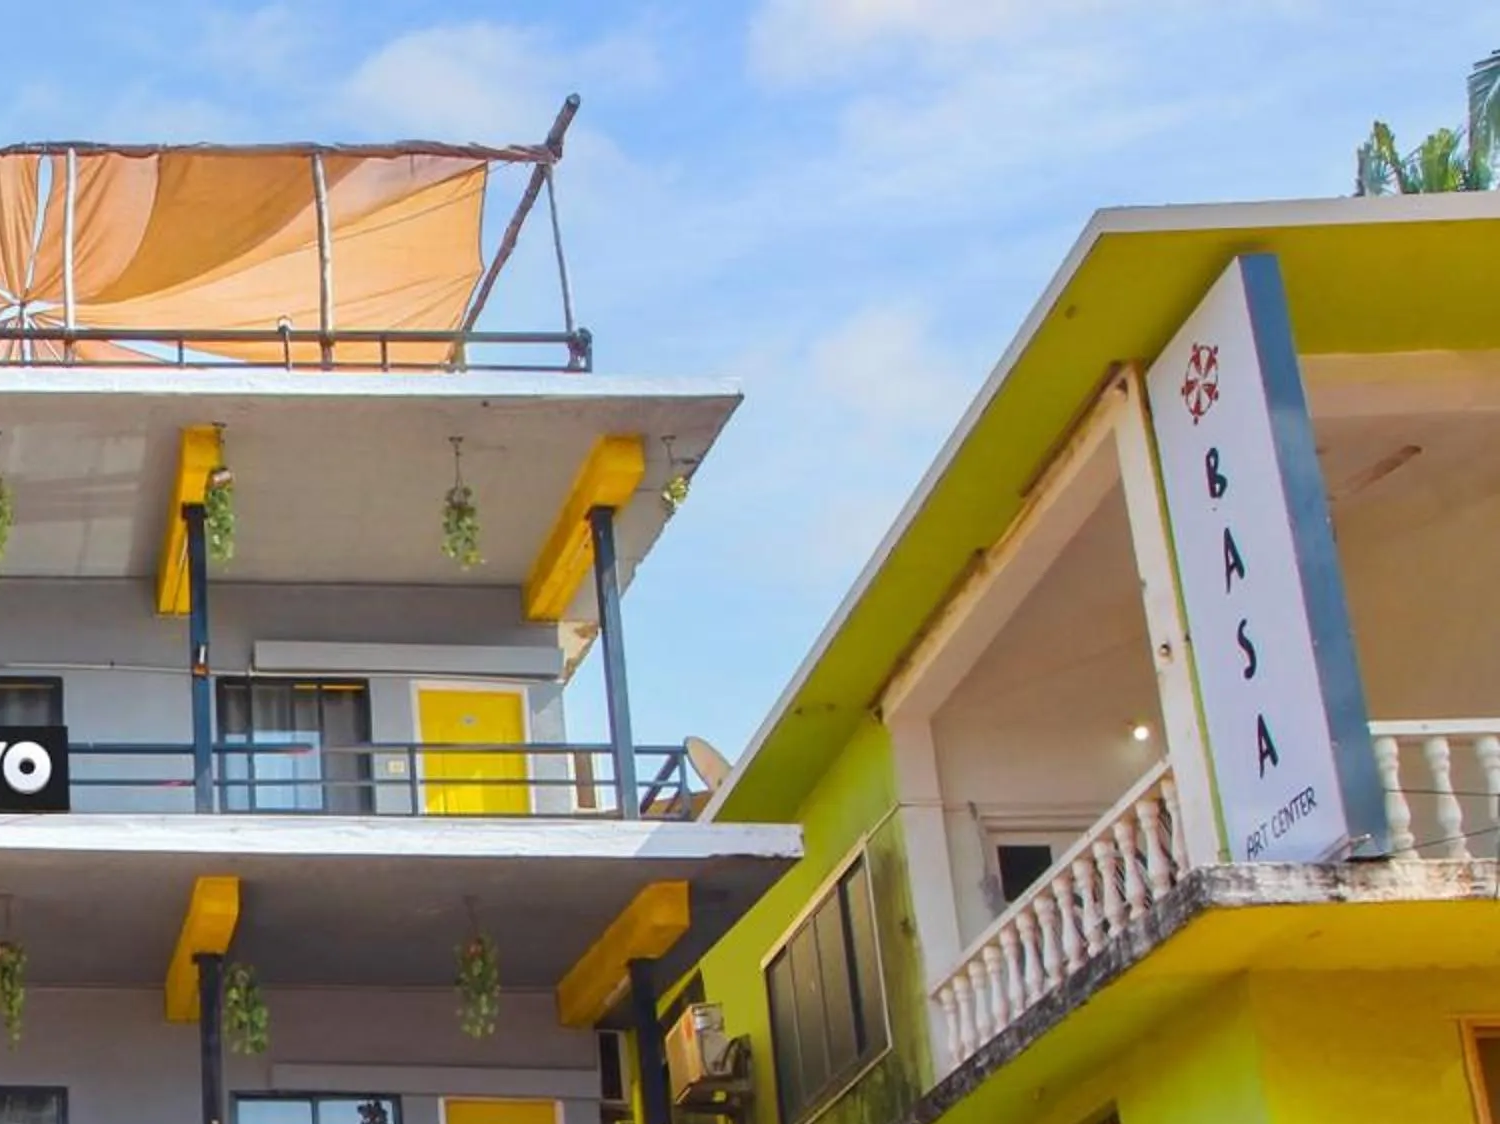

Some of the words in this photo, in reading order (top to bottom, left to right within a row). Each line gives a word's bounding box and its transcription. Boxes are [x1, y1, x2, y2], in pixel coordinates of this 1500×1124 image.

[1204, 446, 1279, 780] BASA
[1246, 822, 1269, 861] ART
[1270, 785, 1317, 839] CENTER
